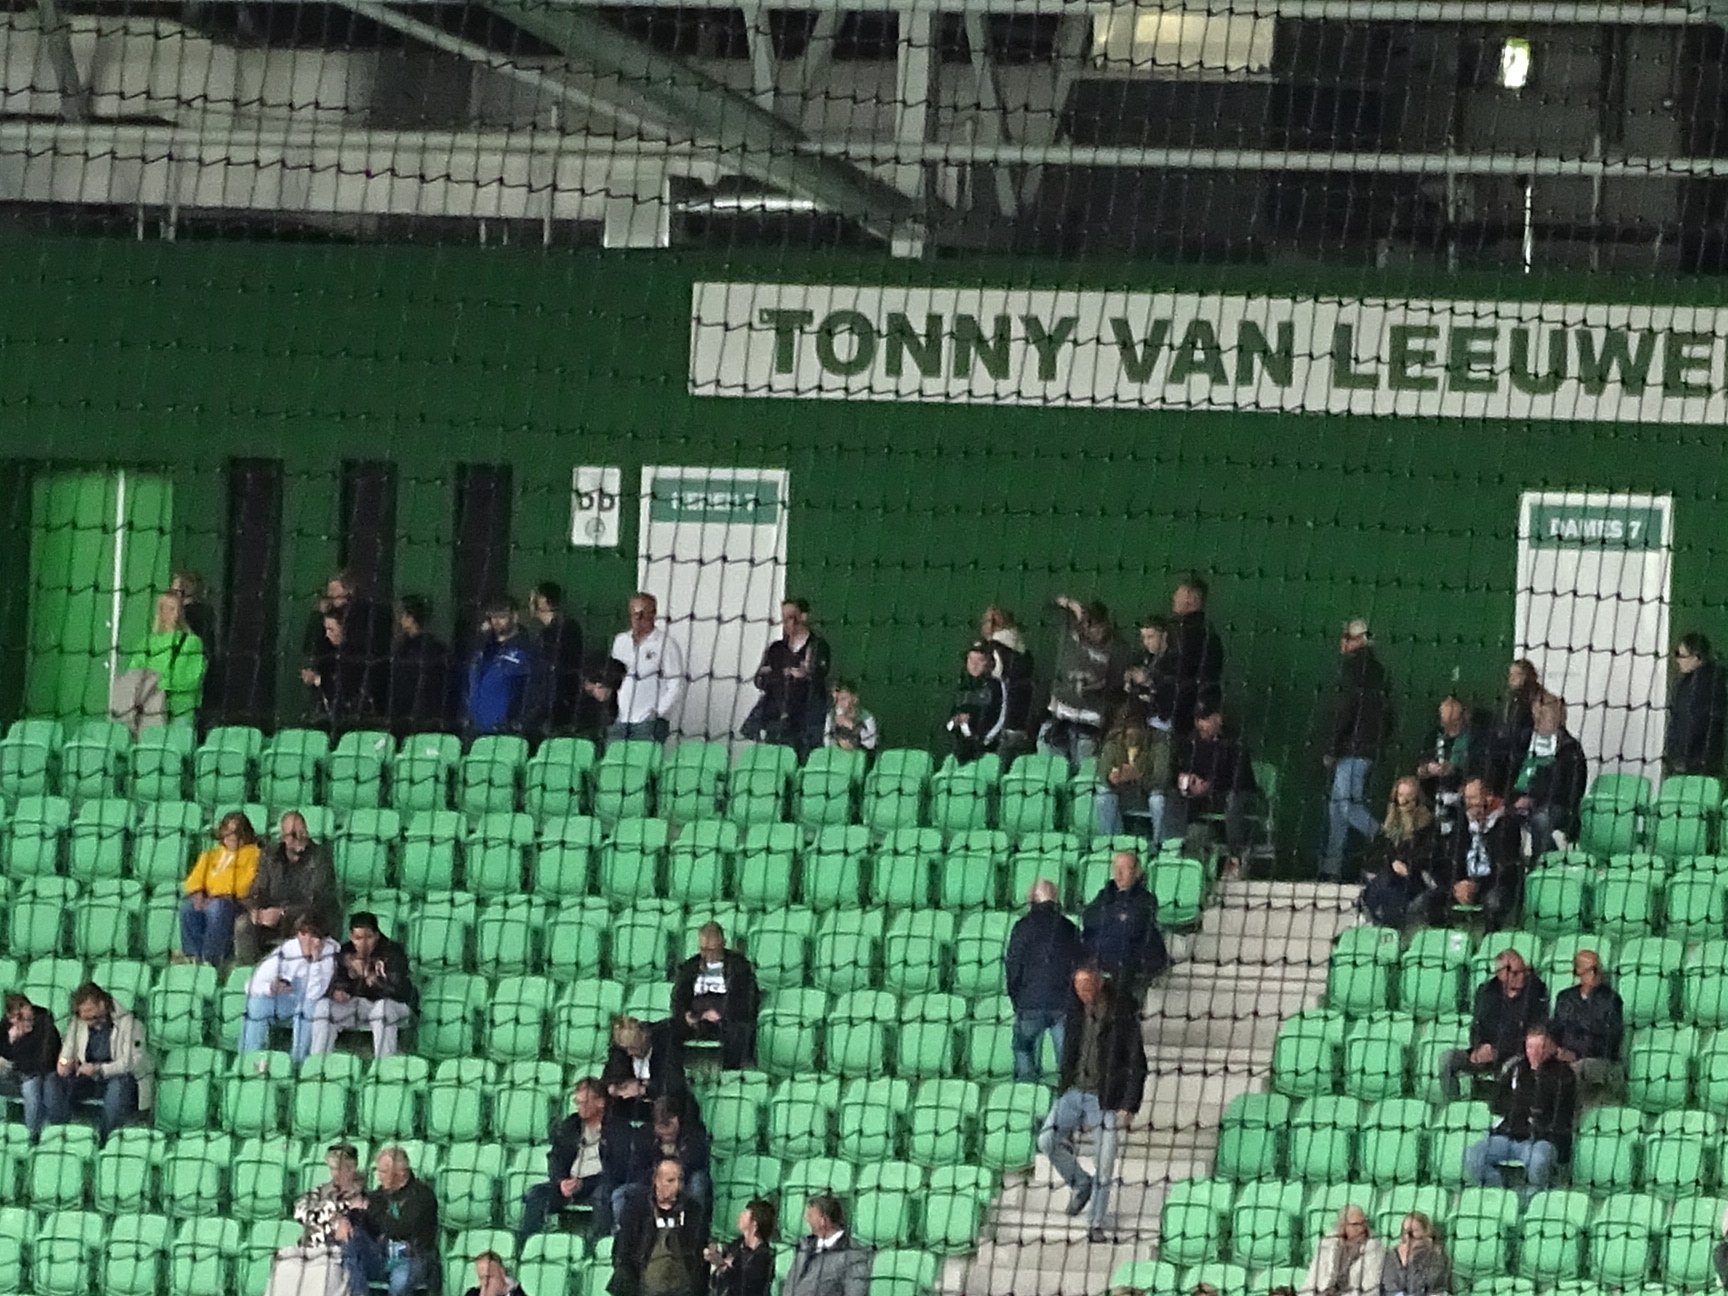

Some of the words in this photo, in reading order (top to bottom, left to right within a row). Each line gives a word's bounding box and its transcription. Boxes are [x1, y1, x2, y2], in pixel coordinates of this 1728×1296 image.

[758, 307, 1078, 382] TONNY
[1110, 317, 1294, 387] VAN
[1549, 517, 1623, 540] DAMES
[1629, 520, 1642, 540] 7
